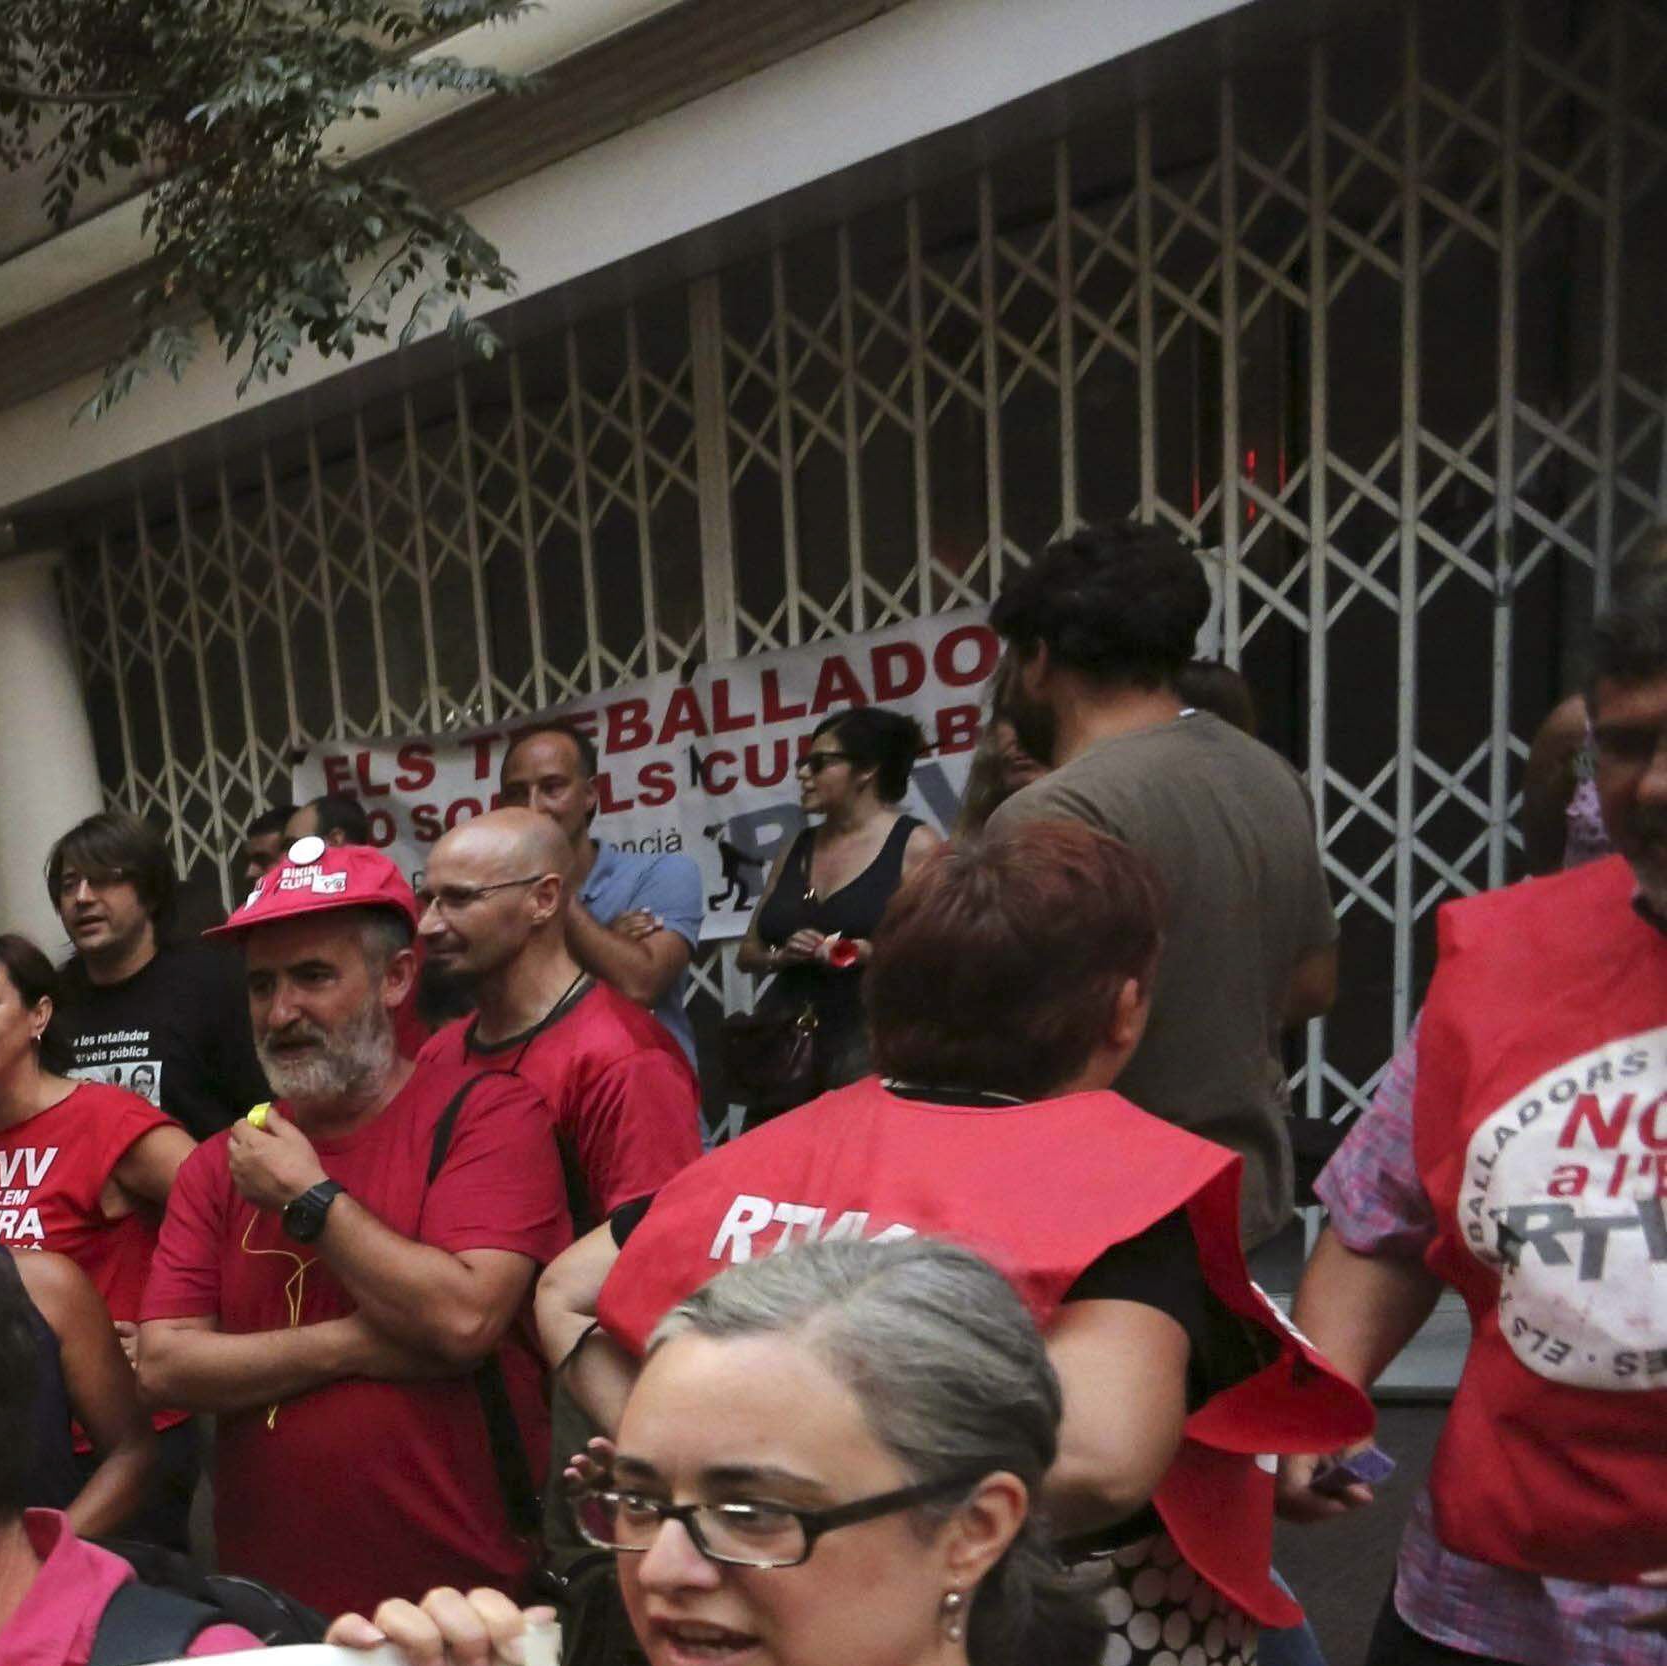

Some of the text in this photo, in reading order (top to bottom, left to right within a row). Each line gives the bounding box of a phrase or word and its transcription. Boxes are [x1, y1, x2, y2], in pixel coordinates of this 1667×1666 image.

[322, 742, 437, 799] ELS
[464, 625, 1000, 781] TBALLADO
[593, 762, 677, 815] LS
[280, 877, 314, 891] CLUB
[282, 864, 323, 879] BIKINI
[97, 1030, 150, 1045] retallades
[75, 1047, 149, 1064] erveis públics
[1467, 1049, 1649, 1246] BALLADORS
[1547, 1163, 1589, 1199] a
